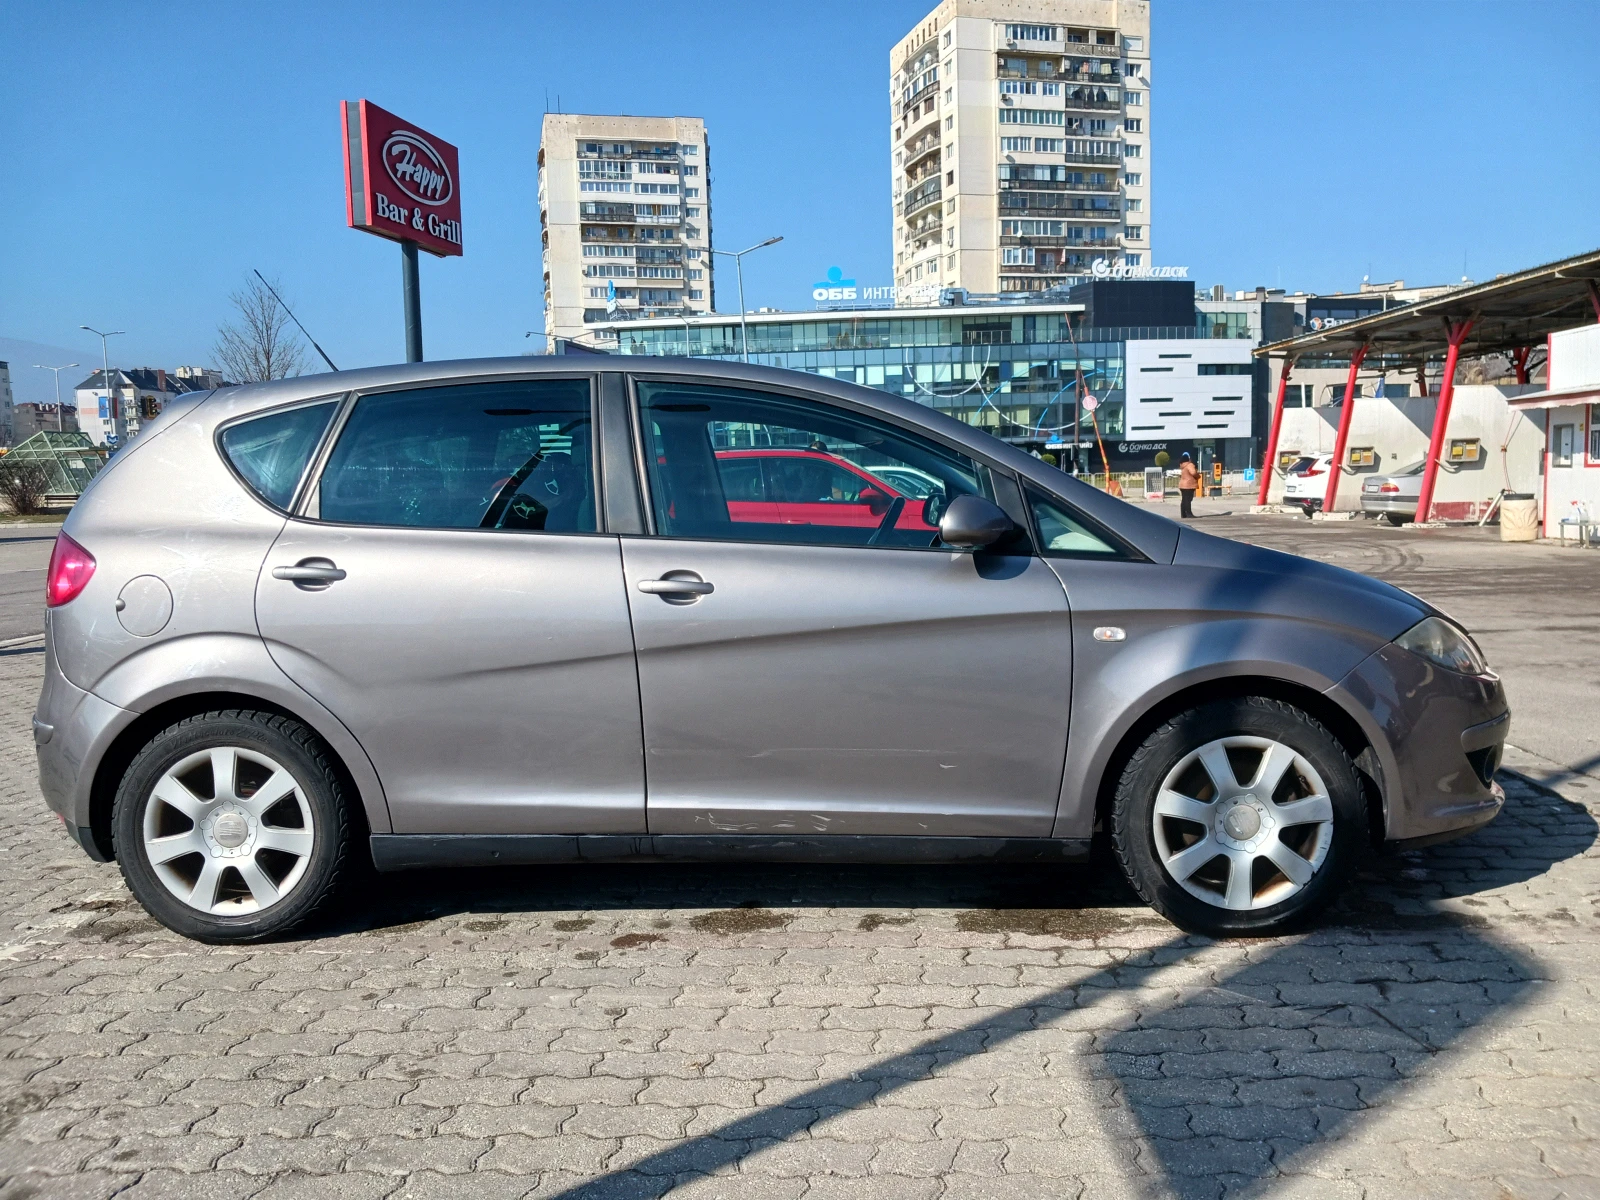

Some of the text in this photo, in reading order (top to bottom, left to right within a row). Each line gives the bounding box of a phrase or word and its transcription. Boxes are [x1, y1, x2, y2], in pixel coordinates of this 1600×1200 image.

[391, 143, 445, 199] Happy
[376, 192, 462, 245] Bar & Grill
[812, 287, 857, 301] ОББ
[1246, 470, 1253, 480] P
